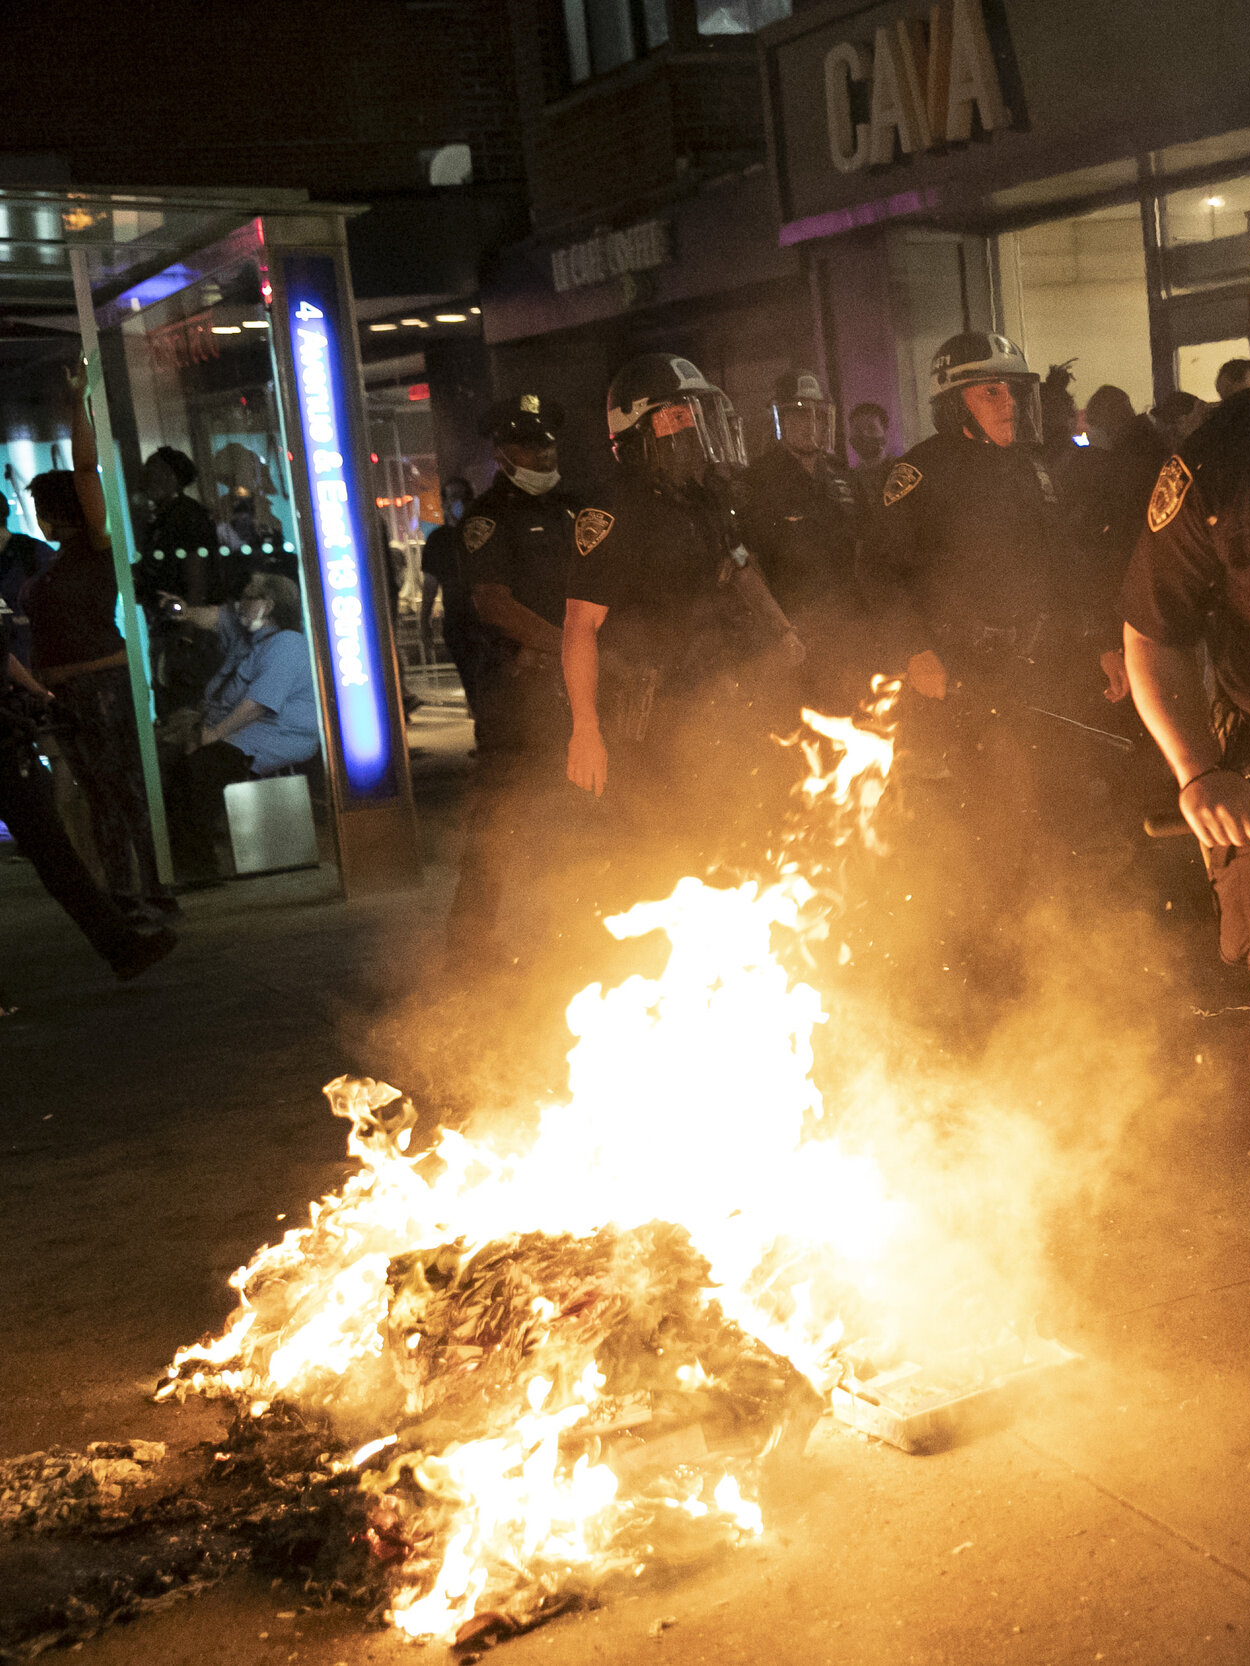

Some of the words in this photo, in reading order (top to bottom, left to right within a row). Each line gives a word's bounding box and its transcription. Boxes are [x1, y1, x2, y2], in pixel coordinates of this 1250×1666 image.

[824, 0, 1010, 173] CAVA
[295, 300, 324, 322] 4
[297, 327, 334, 443] Avenue
[312, 448, 344, 474] &
[316, 480, 352, 549] East
[326, 554, 358, 590] 13
[331, 595, 369, 687] Street
